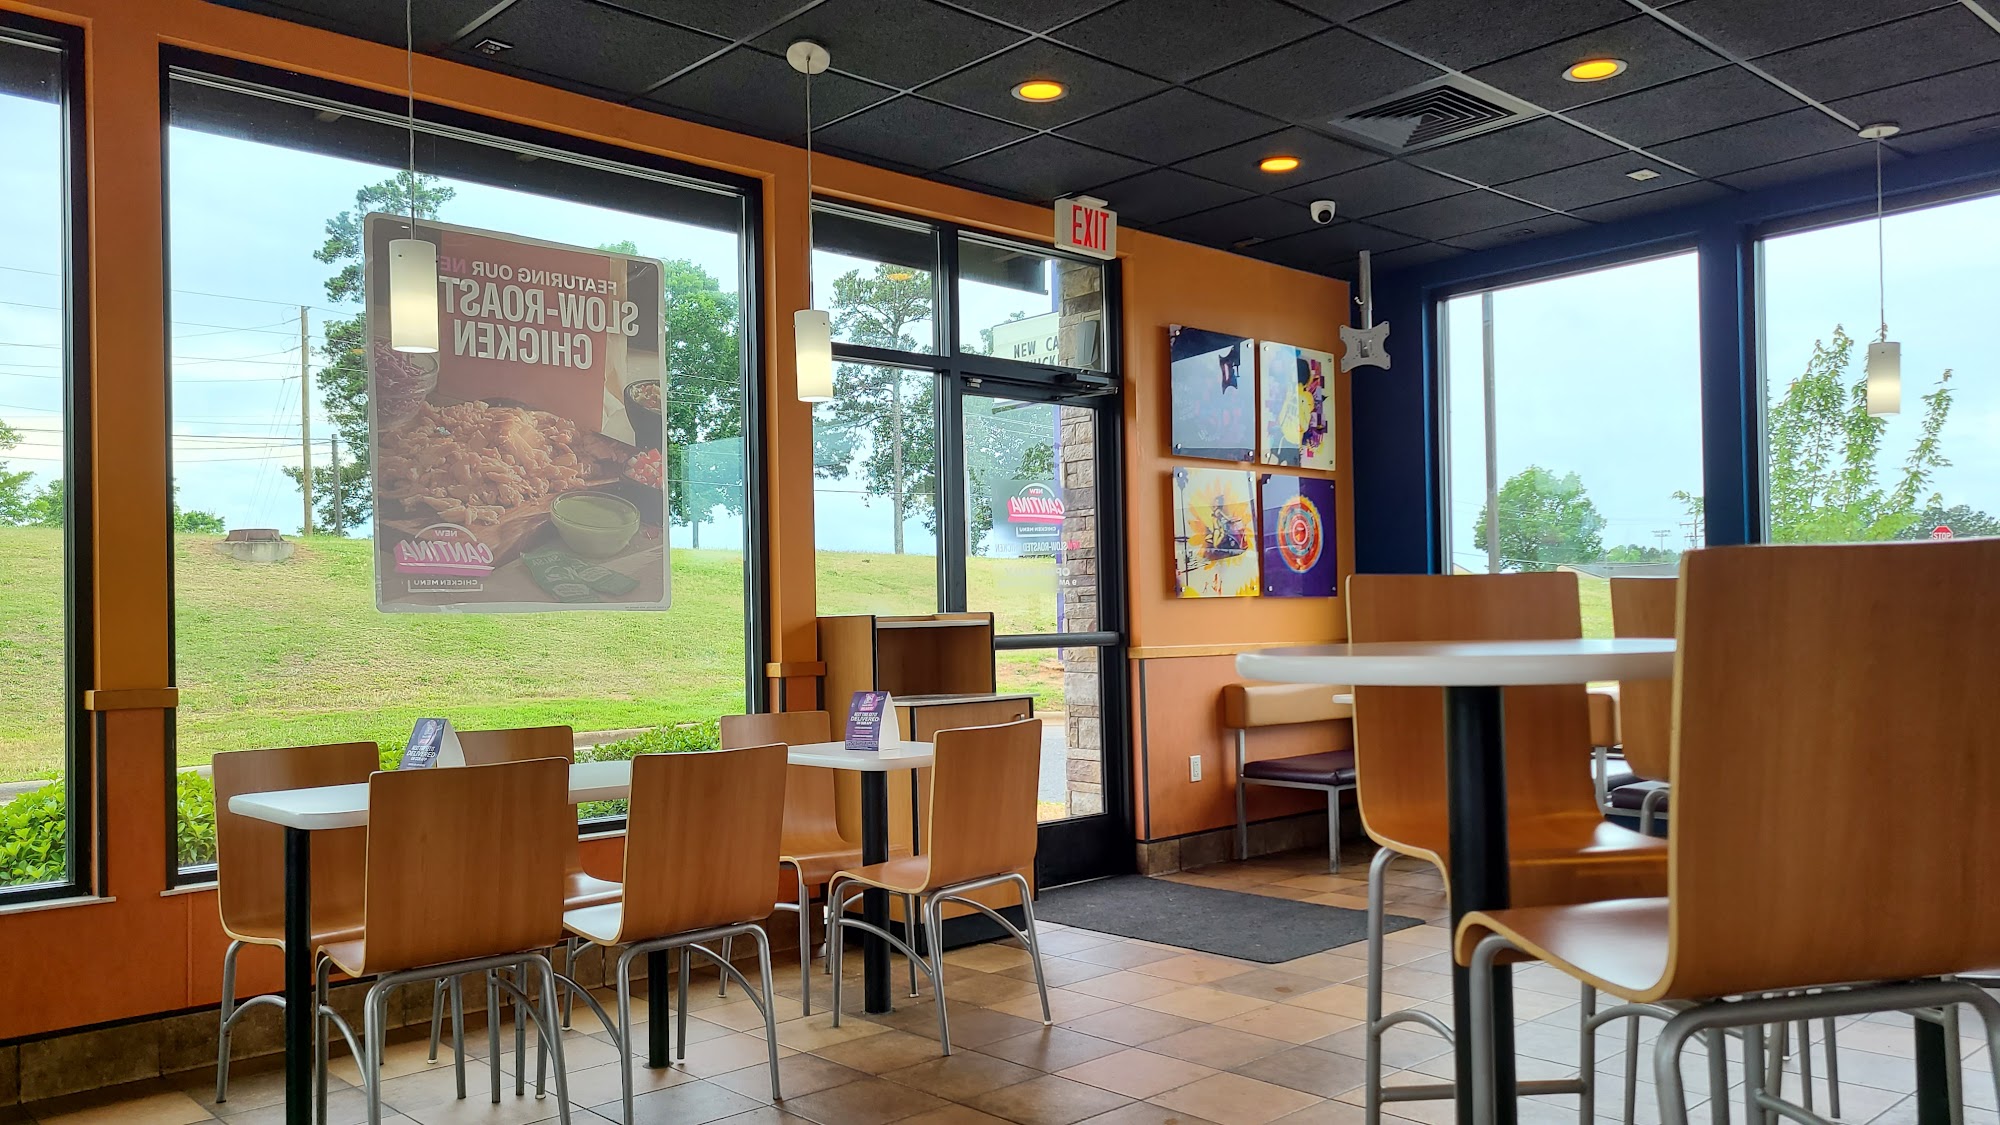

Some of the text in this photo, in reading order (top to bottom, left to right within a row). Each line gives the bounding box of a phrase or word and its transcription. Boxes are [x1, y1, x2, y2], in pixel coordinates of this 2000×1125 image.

[1072, 204, 1109, 251] EXIT
[1014, 336, 1059, 358] NEW CA
